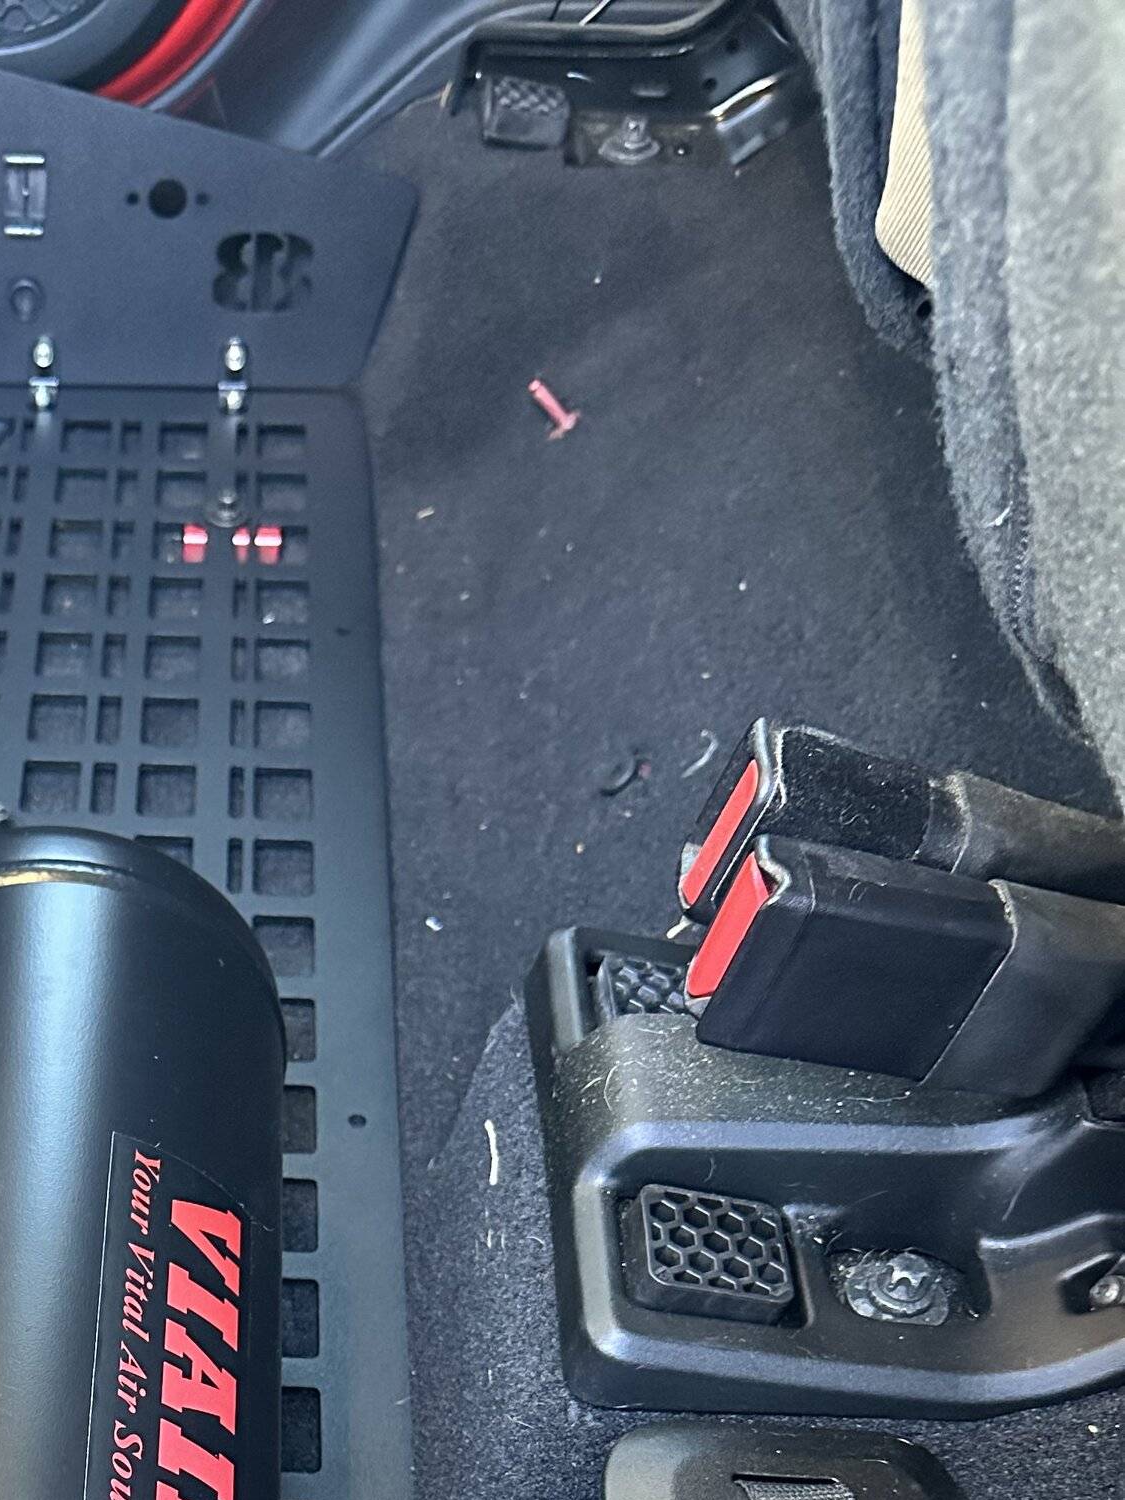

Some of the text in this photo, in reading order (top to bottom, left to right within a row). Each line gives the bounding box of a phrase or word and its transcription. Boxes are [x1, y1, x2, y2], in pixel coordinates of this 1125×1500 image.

[129, 1147, 162, 1235] Your
[121, 1240, 156, 1341] Vital
[116, 1343, 147, 1412] Air
